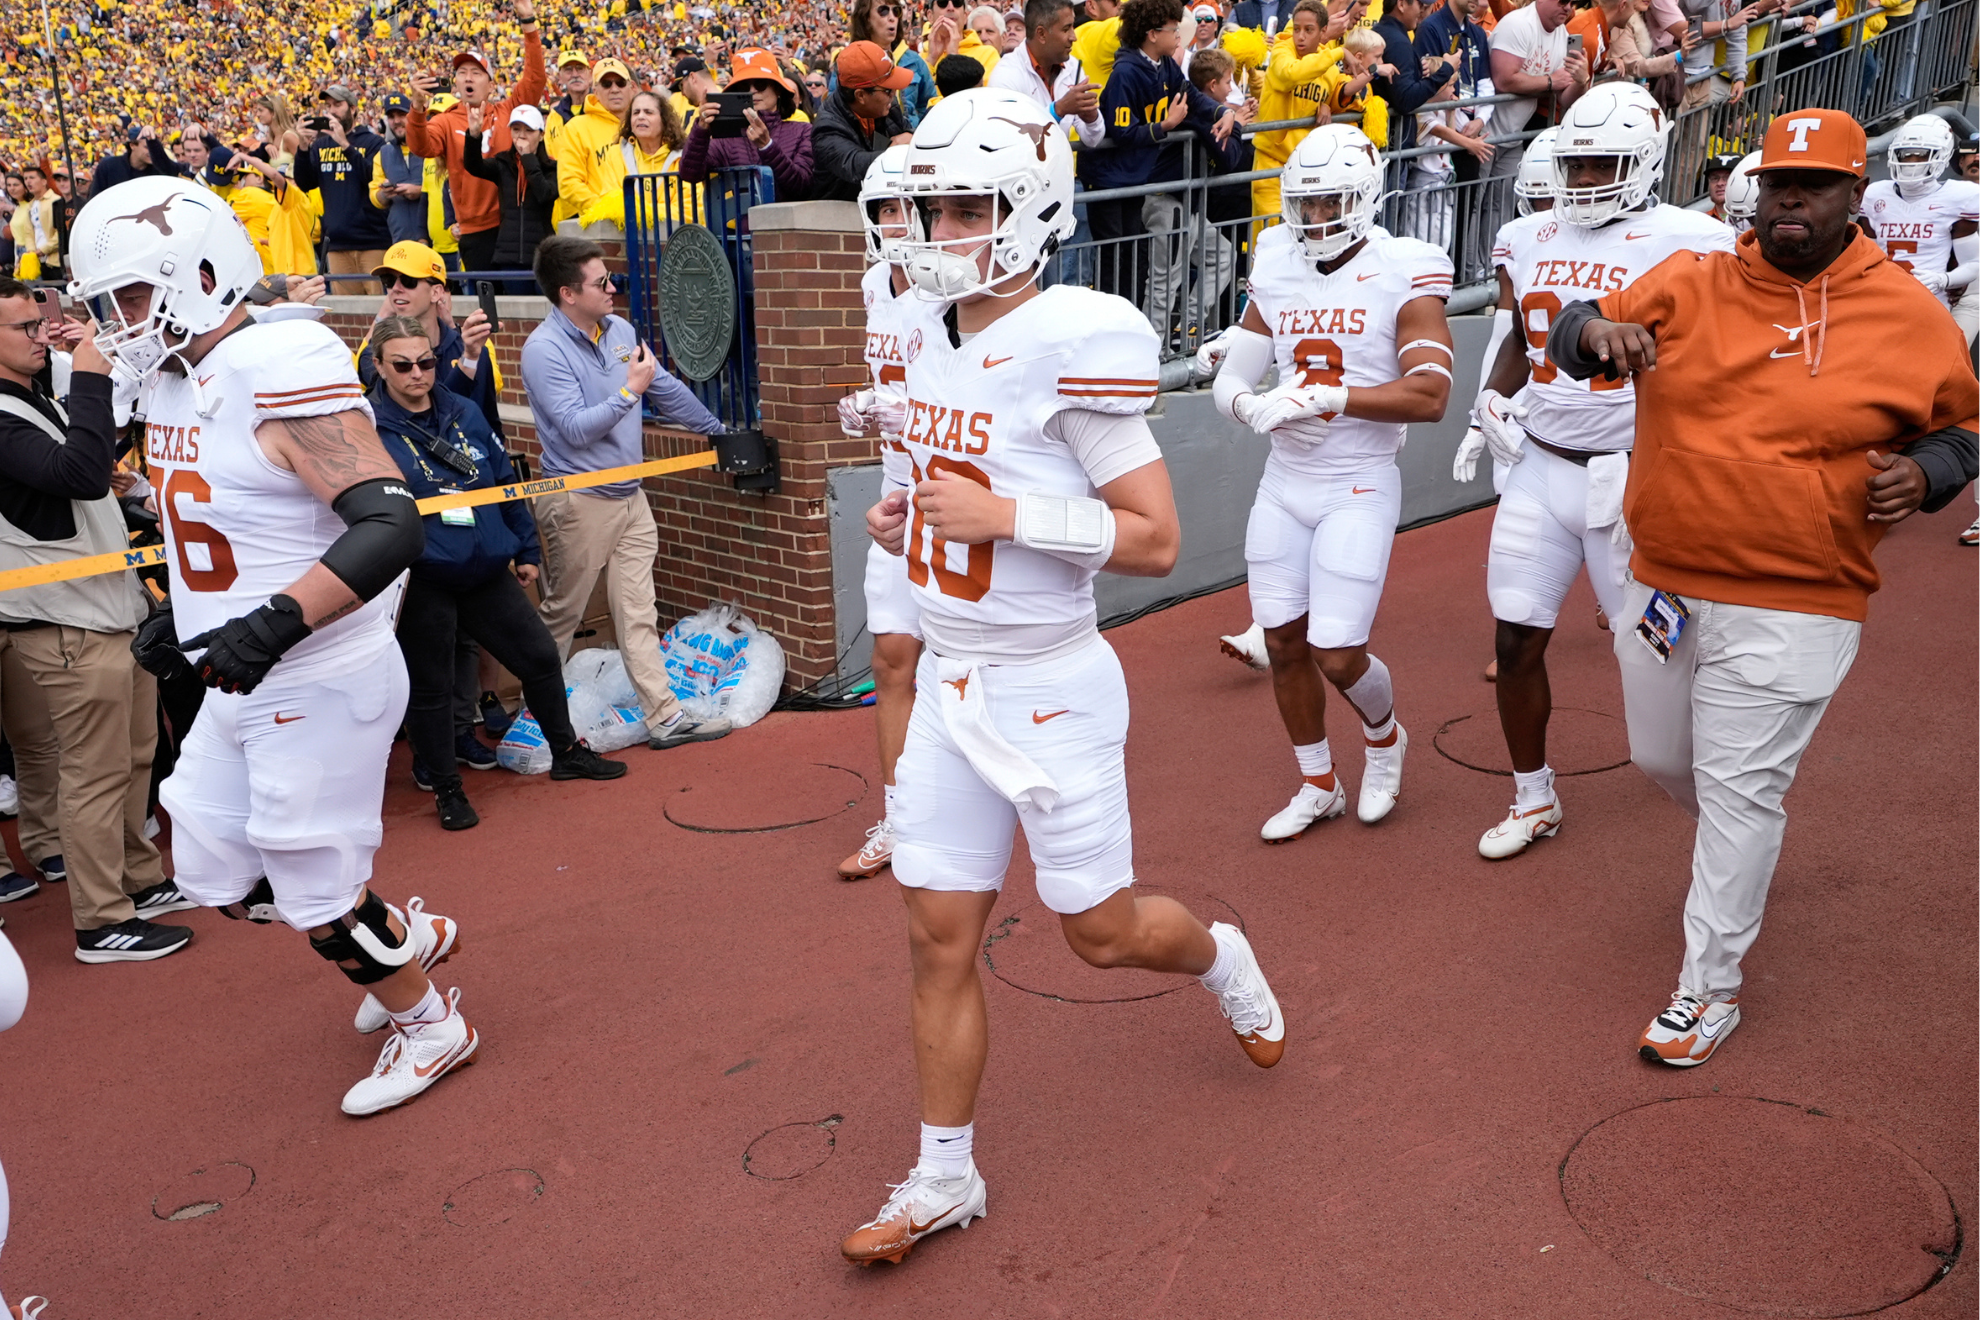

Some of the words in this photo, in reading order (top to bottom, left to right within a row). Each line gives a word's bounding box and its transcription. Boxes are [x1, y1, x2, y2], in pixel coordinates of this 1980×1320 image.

[390, 96, 400, 104] M
[1114, 106, 1130, 127] 10
[1787, 118, 1822, 152] T
[320, 163, 332, 172] GO
[335, 172, 345, 180] M
[1880, 223, 1934, 238] TEXAS
[696, 232, 710, 250] OF
[1532, 260, 1628, 292] TEXAS
[1278, 308, 1366, 336] TEXAS
[146, 422, 200, 462] TEXAS
[502, 486, 518, 498] M
[521, 478, 566, 496] MICHIGAN
[124, 551, 146, 566] M
